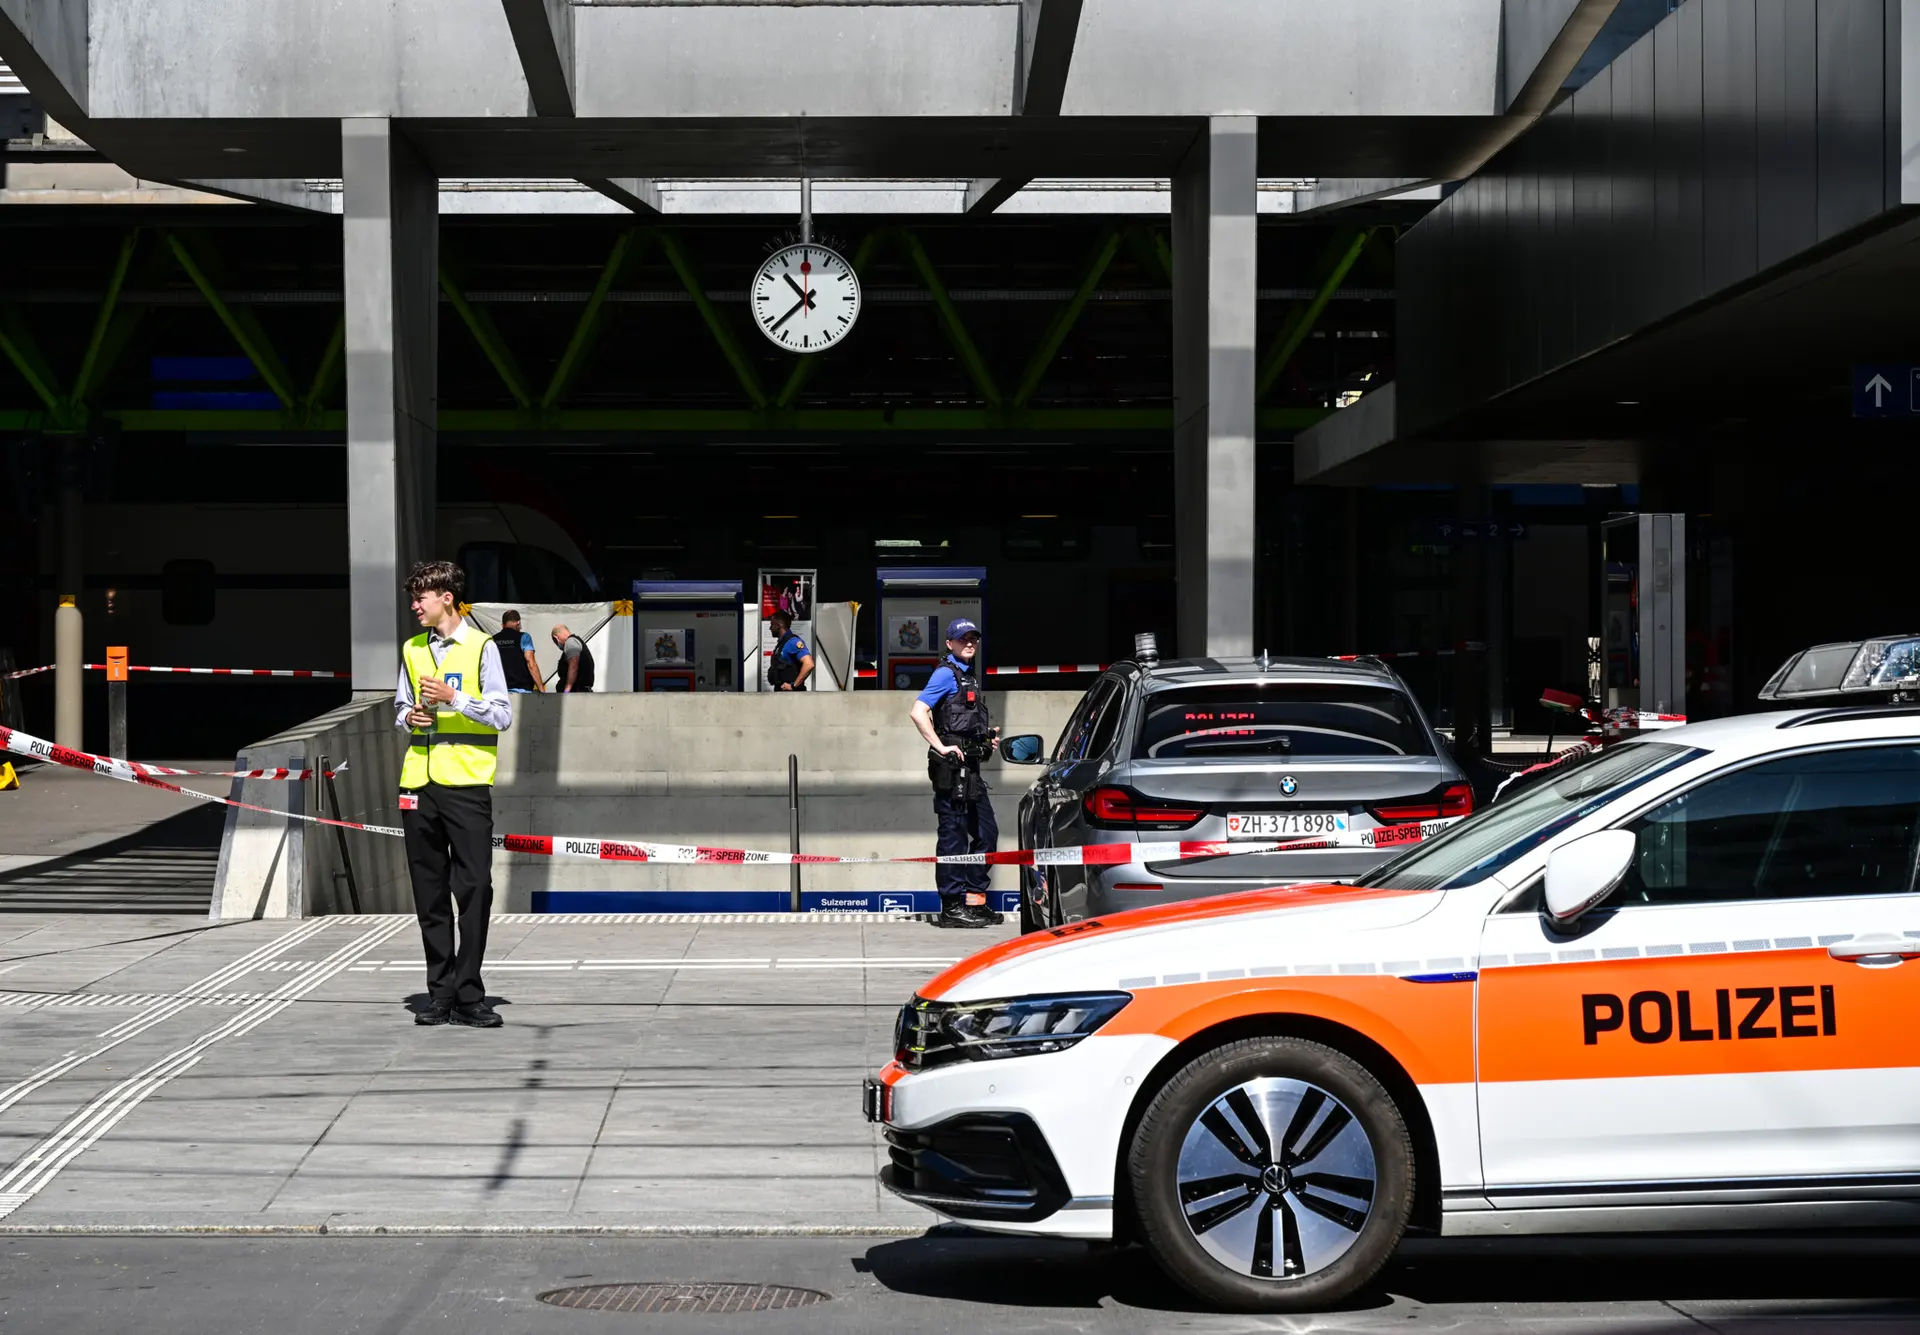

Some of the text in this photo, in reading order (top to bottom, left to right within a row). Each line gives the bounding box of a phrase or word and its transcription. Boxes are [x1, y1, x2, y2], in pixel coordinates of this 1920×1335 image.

[30, 740, 113, 776] POLIZEI-SPERRZONE
[492, 836, 545, 851] SPERRZONE
[1361, 821, 1449, 846] POLIZEI-SPERRZONE
[820, 898, 869, 907] Sulzerareal
[1581, 984, 1838, 1046] POLIZEI
